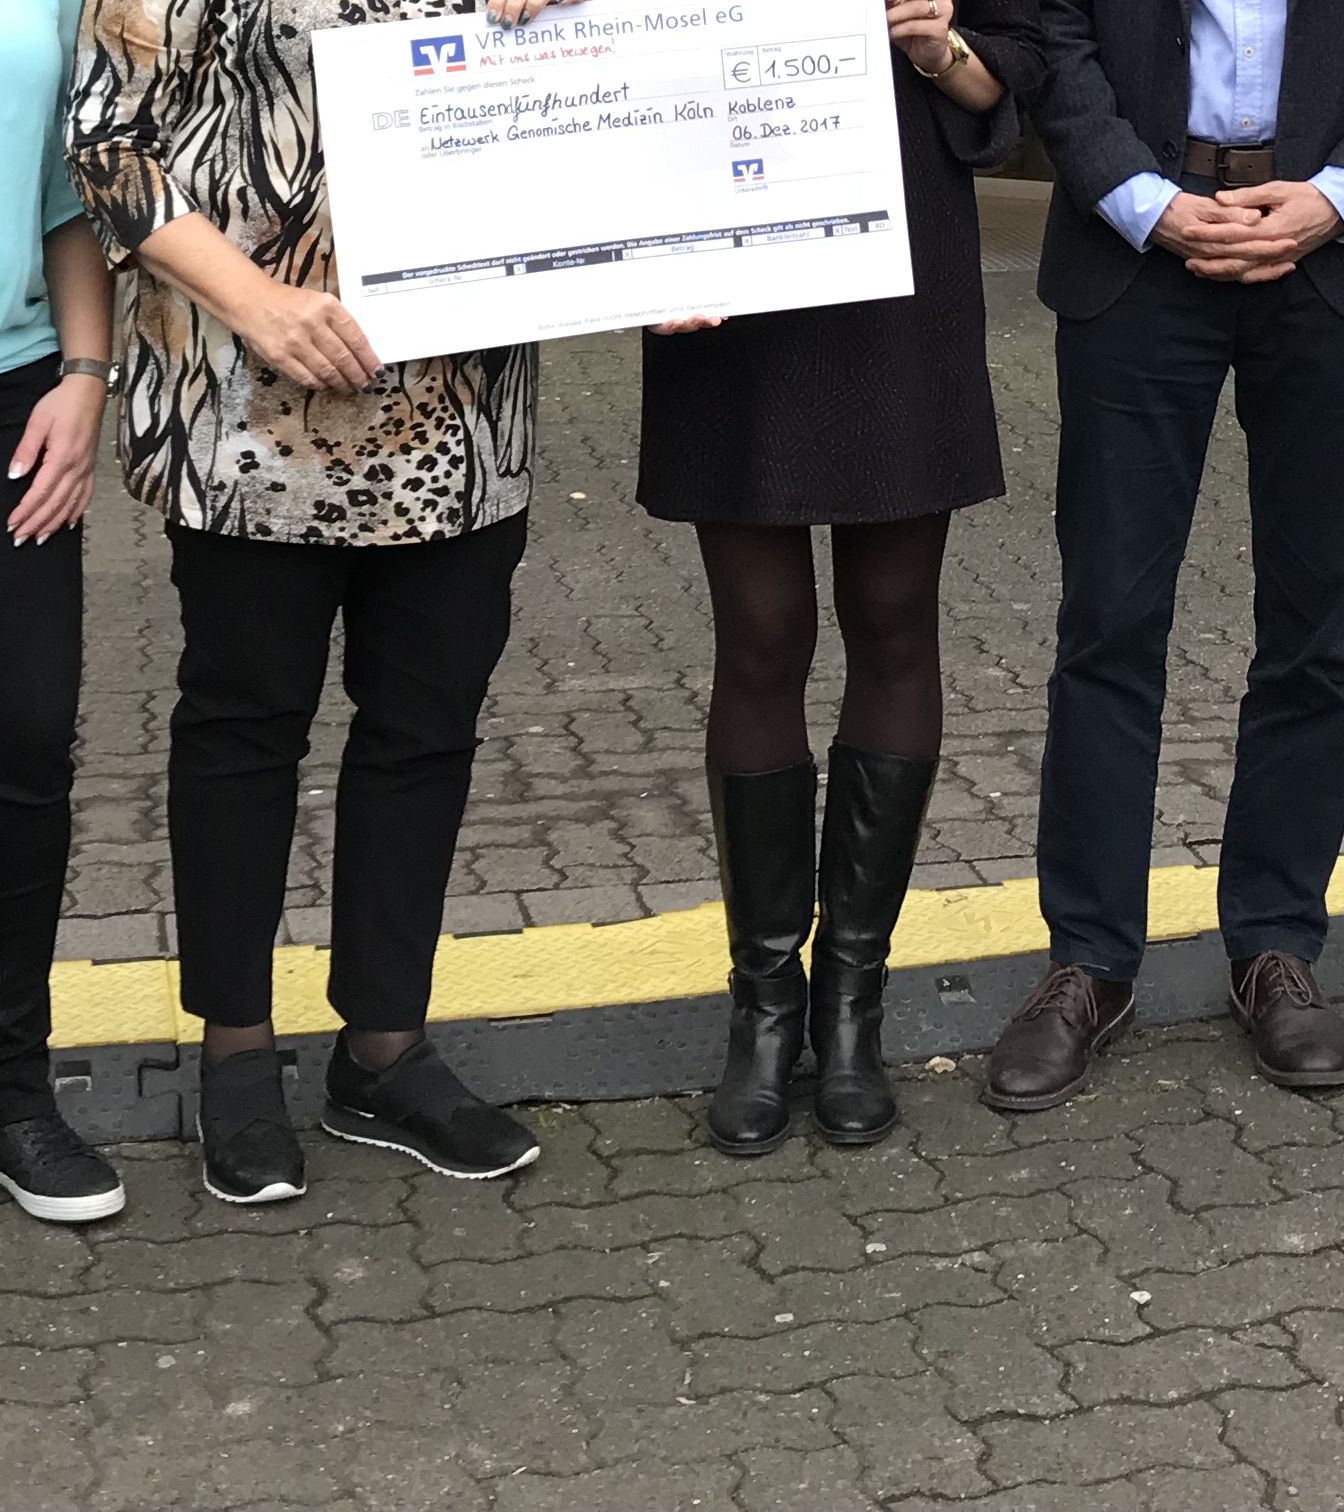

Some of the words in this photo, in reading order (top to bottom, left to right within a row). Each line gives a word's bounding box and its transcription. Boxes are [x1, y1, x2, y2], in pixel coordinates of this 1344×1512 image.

[475, 31, 506, 50] VR
[515, 23, 566, 46] Bank
[574, 8, 707, 40] Rhein-Mosel
[715, 4, 744, 24] eG
[479, 53, 504, 68] Mit
[509, 51, 530, 63] uns
[534, 49, 557, 62] was
[731, 61, 752, 83] €
[415, 87, 442, 97] Zahlen
[443, 84, 455, 94] Sie
[456, 82, 482, 94] gegen
[509, 76, 536, 87] Scheck
[419, 82, 630, 125] Eintausendfünfhundert
[728, 95, 796, 117] Koblenz
[372, 109, 411, 131] DE
[430, 130, 499, 151] Netzwerk
[506, 118, 593, 141] Genomische
[596, 107, 665, 131] Medizin
[674, 100, 714, 122] Köln
[732, 125, 758, 141] 06.
[760, 121, 797, 139] Dez.
[800, 115, 841, 133] 2017
